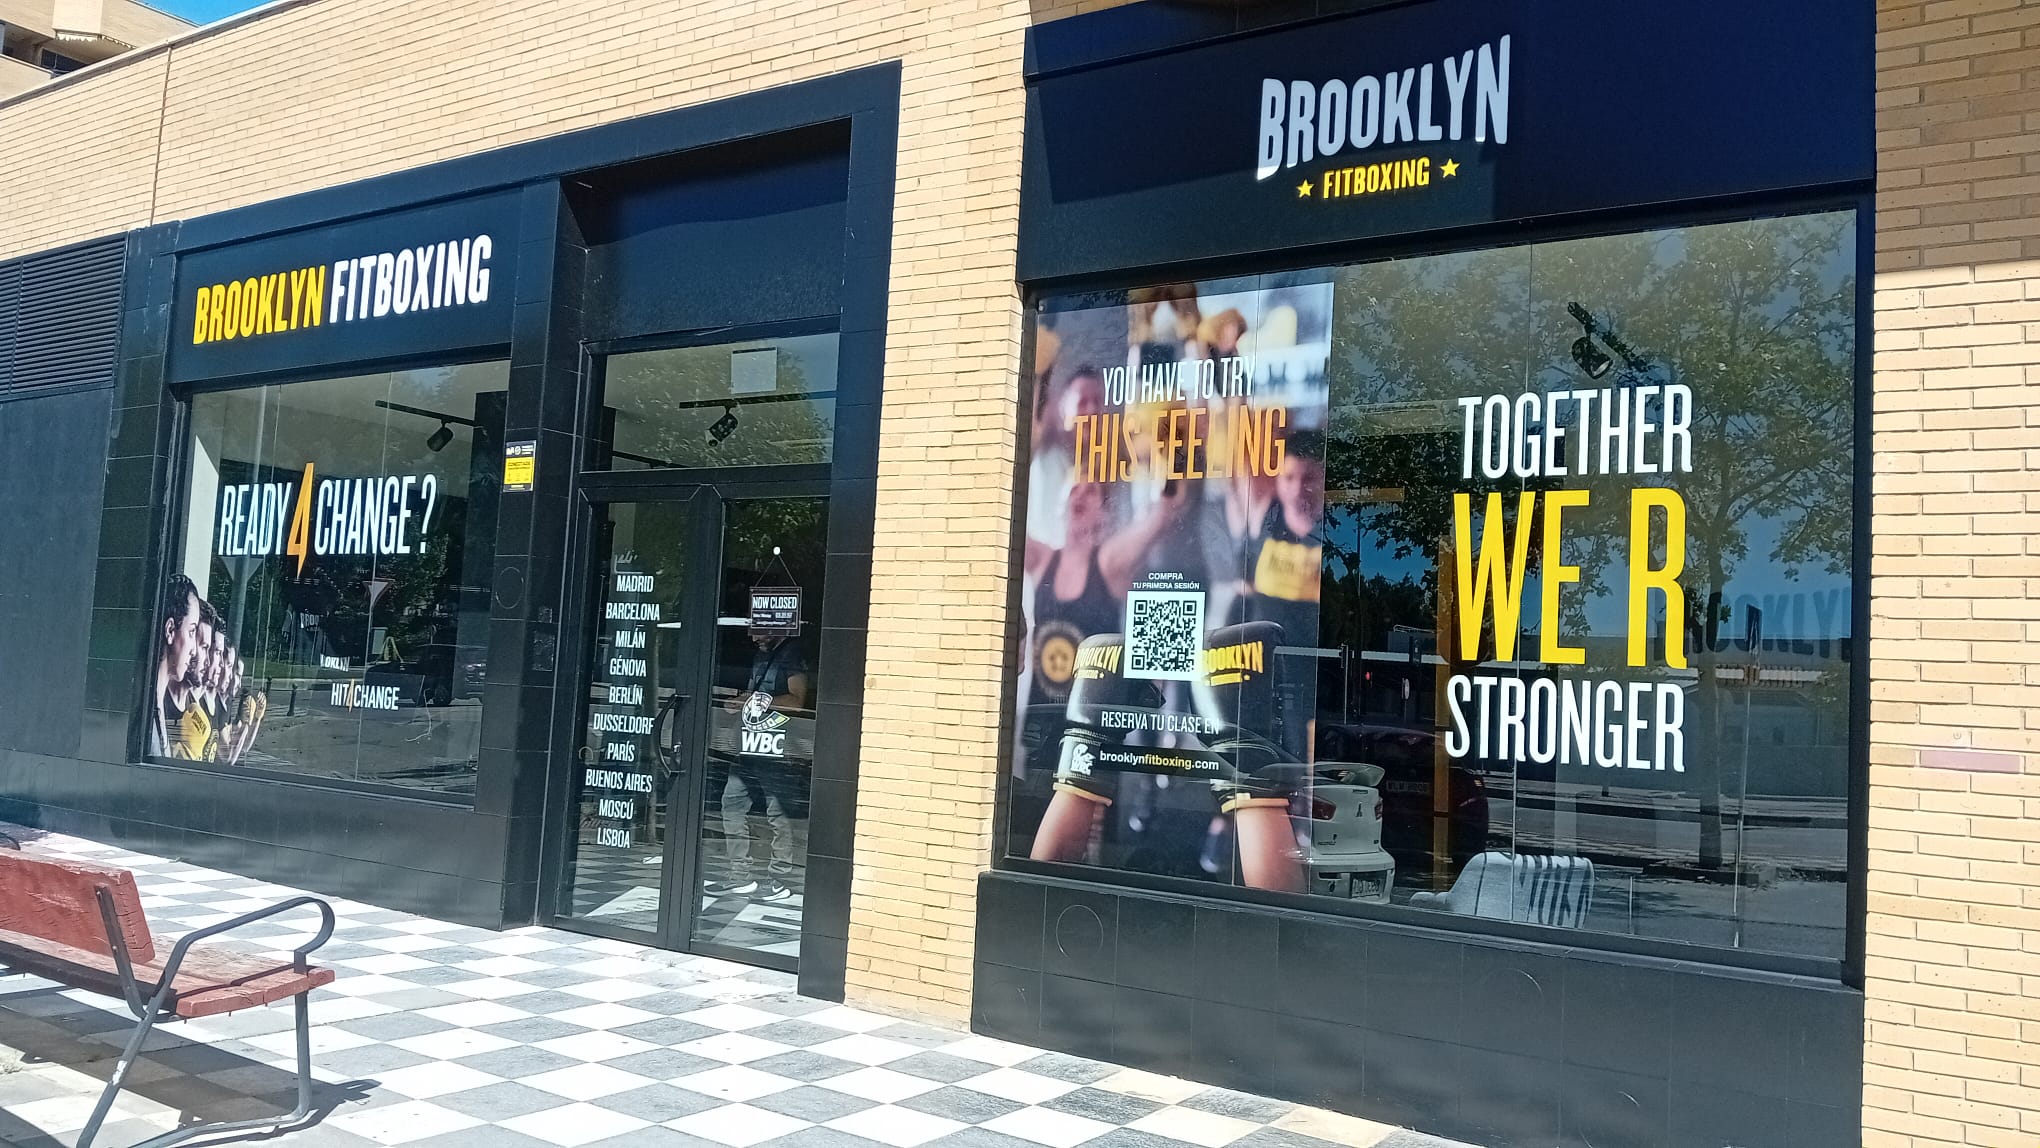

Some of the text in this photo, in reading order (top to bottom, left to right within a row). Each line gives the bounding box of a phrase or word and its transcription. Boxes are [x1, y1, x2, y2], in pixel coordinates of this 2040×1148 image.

[1257, 34, 1511, 181] BROOKLYN
[1323, 156, 1430, 199] FITBOXING
[193, 234, 492, 345] BROOKLYN FITBOXING
[1102, 355, 1256, 407] YOU HAVE TO TRY
[1458, 383, 1693, 479] TOGETHER
[1073, 404, 1287, 483] THIS FEELING
[218, 482, 292, 555] READY
[616, 575, 654, 592] MADRID
[1148, 572, 1184, 580] COMPRA
[1174, 581, 1200, 589] SESIÓN
[1453, 487, 1688, 669] WE R
[605, 602, 660, 621] BARCELONA
[752, 596, 797, 609] NOW CLOSED
[615, 628, 646, 648] MILÁN
[609, 655, 647, 677] GÉNOVA
[609, 684, 643, 705] BERLÍN
[593, 713, 655, 735] DUSSELDORF
[1101, 711, 1220, 735] RESERVA TU CLASE EN
[1444, 674, 1685, 773] STRONGER
[606, 741, 635, 762] PARÍS
[741, 731, 785, 755] WBC
[1100, 750, 1220, 771] brooklynfitboxing.com
[585, 769, 653, 793] BUENOS AIRES
[598, 799, 634, 820] MOSCÚ
[597, 827, 631, 848] LISBOA
